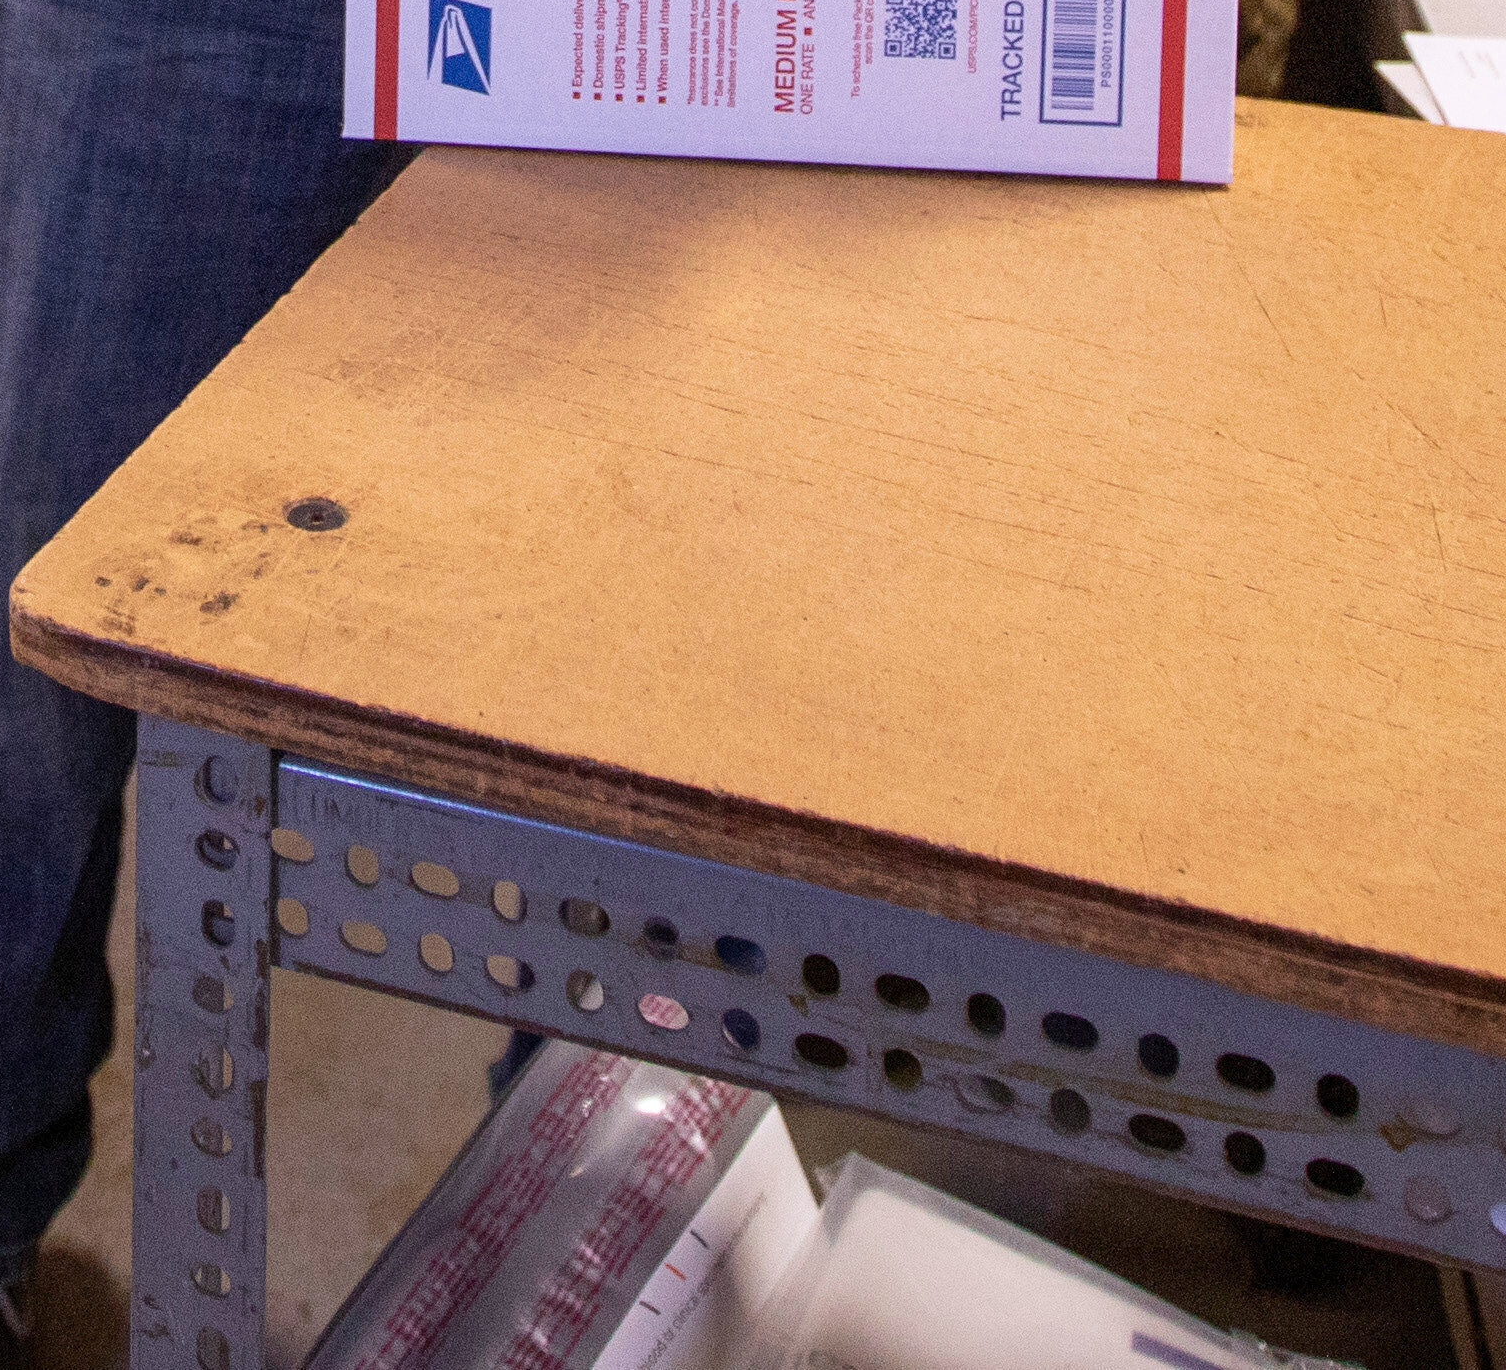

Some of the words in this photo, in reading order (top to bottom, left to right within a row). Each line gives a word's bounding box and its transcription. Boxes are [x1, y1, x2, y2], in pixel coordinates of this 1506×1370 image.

[852, 21, 862, 41] free
[863, 7, 874, 23] QR
[863, 23, 874, 40] the
[657, 25, 670, 56] used
[864, 40, 873, 64] scan
[570, 31, 585, 88] Expected
[591, 32, 605, 89] Domestic
[613, 54, 626, 90] USPS
[634, 46, 648, 91] Limited
[655, 57, 669, 92] When
[772, 8, 797, 113] MEDIUM
[799, 43, 815, 80] RATE
[851, 41, 861, 84] schedule
[798, 83, 814, 115] ONE
